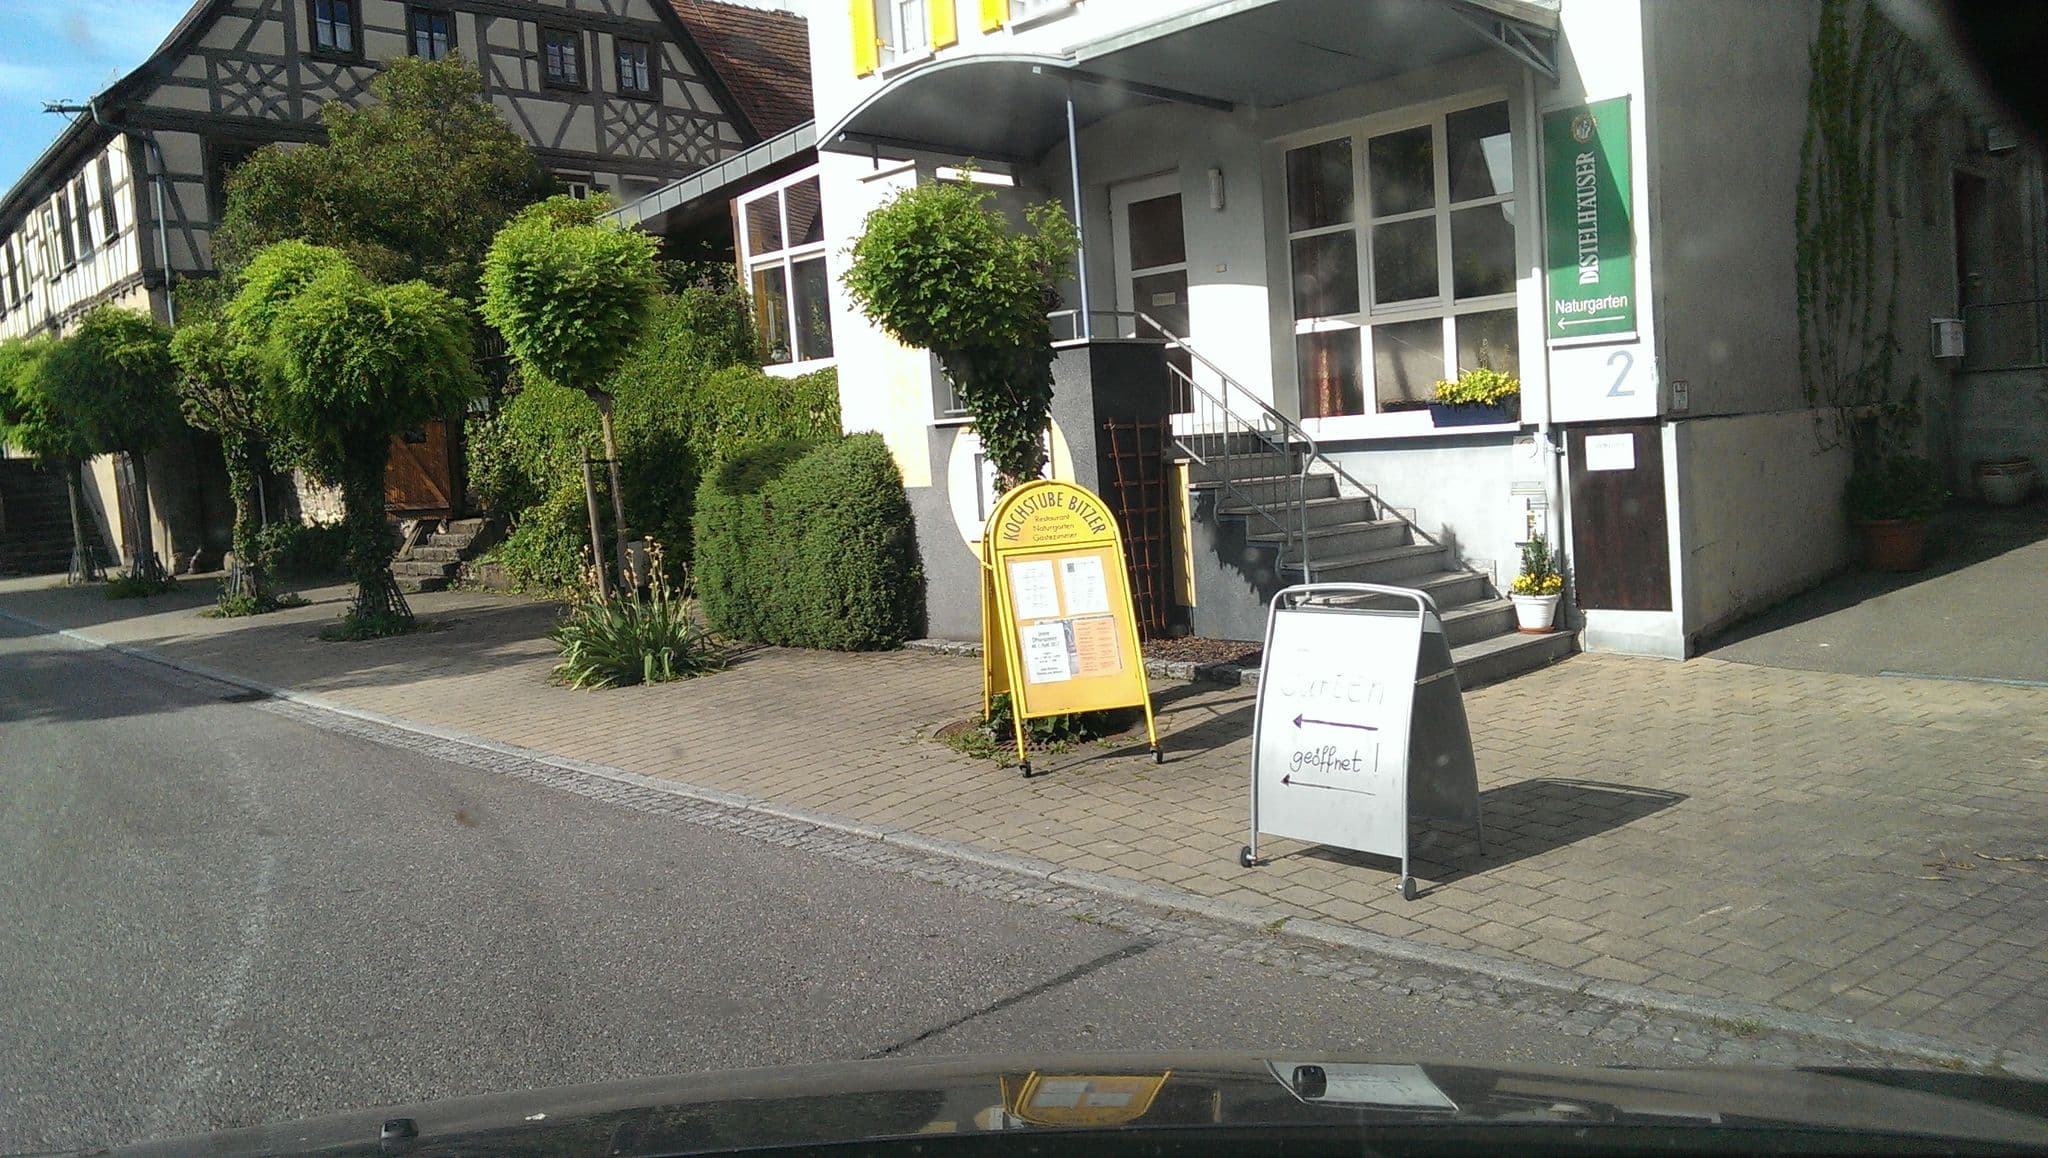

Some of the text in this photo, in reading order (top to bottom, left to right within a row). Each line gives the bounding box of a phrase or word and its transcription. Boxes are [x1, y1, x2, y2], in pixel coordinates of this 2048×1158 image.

[1575, 151, 1600, 286] DISTELHÄUSER
[1555, 294, 1628, 315] Naturgarten
[1607, 350, 1635, 397] 2
[1003, 492, 1107, 541] KOCHSTUBE BITZER
[1033, 523, 1075, 533] Naturgarten
[1034, 513, 1071, 523] Restaurant
[1290, 744, 1362, 773] geöffnet
